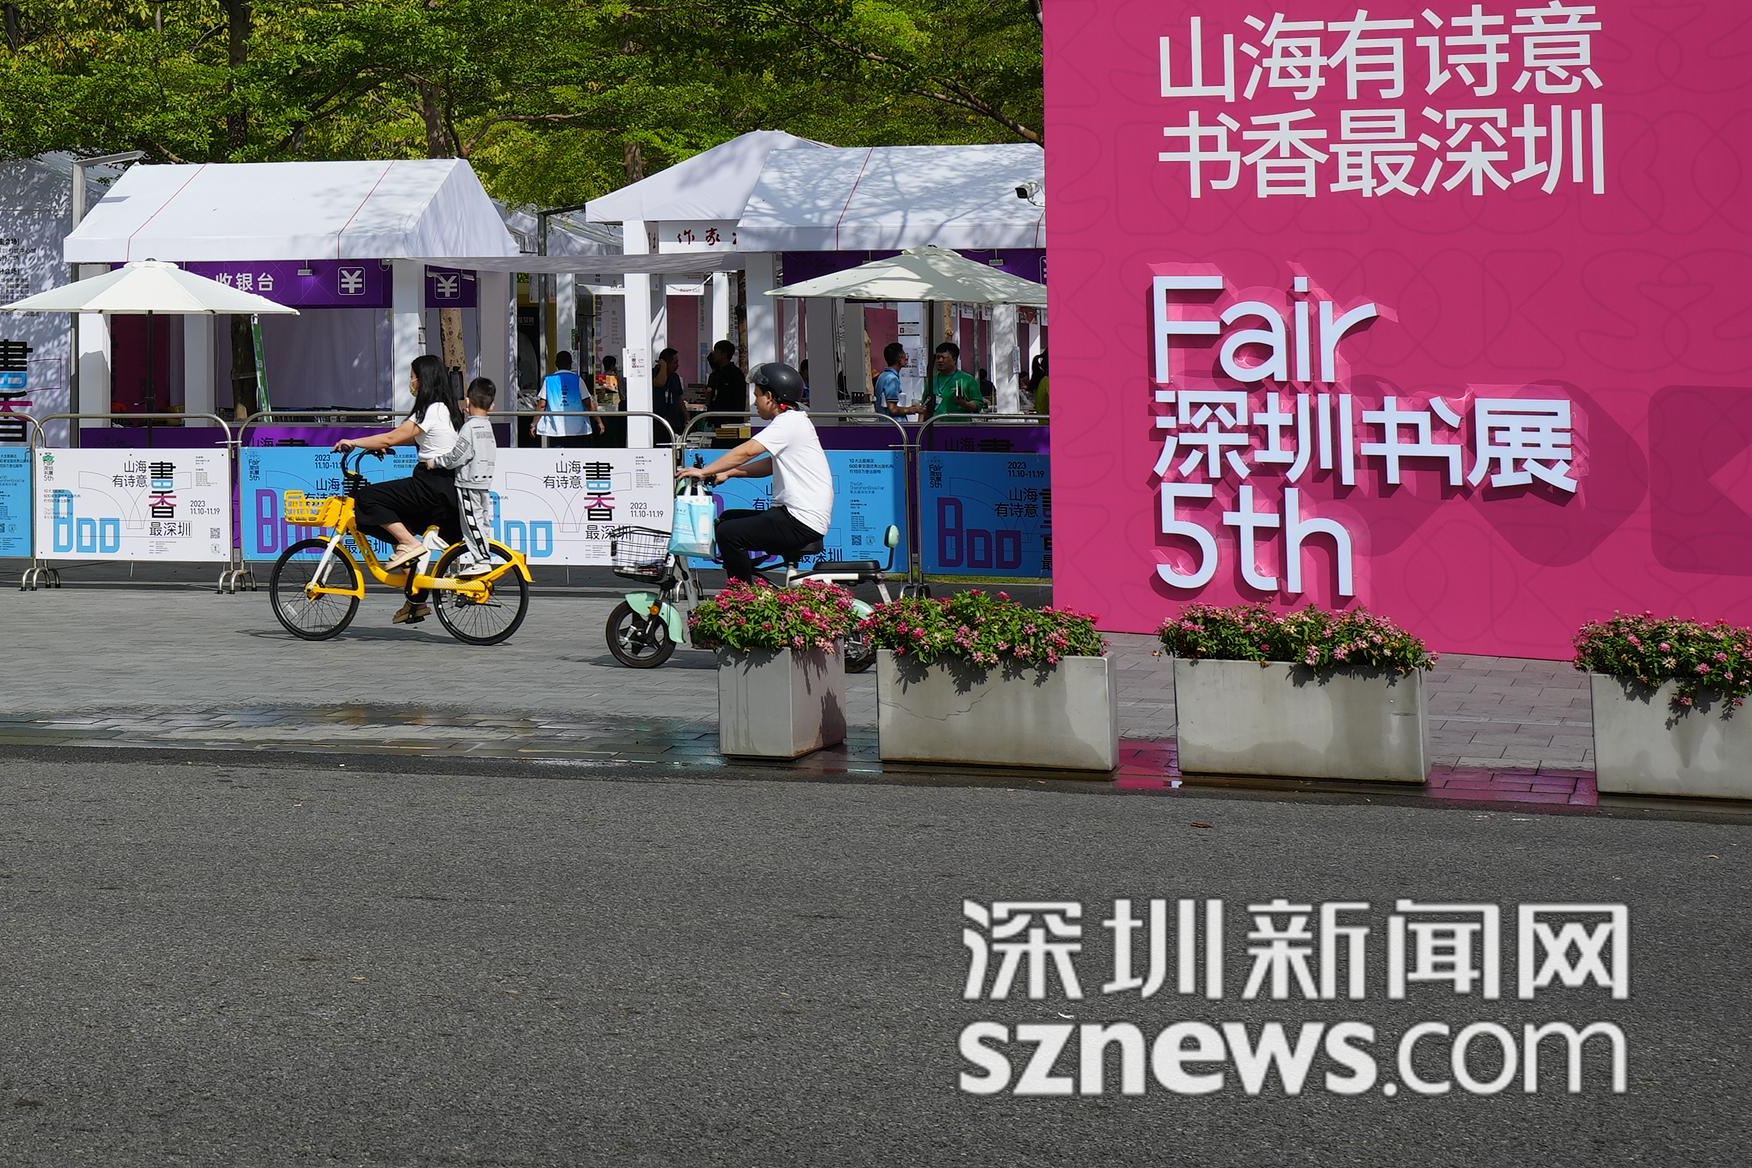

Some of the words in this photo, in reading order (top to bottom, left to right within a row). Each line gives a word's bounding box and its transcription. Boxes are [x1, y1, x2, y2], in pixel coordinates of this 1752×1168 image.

[1158, 0, 1604, 103] 山海有诗意
[1158, 102, 1605, 198] 书香最深圳
[677, 227, 737, 246] 作家
[215, 272, 274, 291] 收银台
[1153, 276, 1377, 384] Fair
[1153, 390, 1578, 493] 深圳书展
[314, 454, 331, 462] 2023
[124, 460, 148, 473] 山海
[555, 460, 581, 474] 山海
[1008, 461, 1027, 470] 2023
[112, 474, 148, 488] 有诗意
[316, 478, 341, 492] 山海
[543, 475, 583, 489] 有诗意
[1009, 488, 1039, 502] 山海
[630, 502, 648, 510] 2023
[994, 503, 1039, 518] 有诗意
[630, 510, 664, 518] 11.10-11.19
[149, 522, 191, 537] 最深圳
[1156, 483, 1355, 597] 5th
